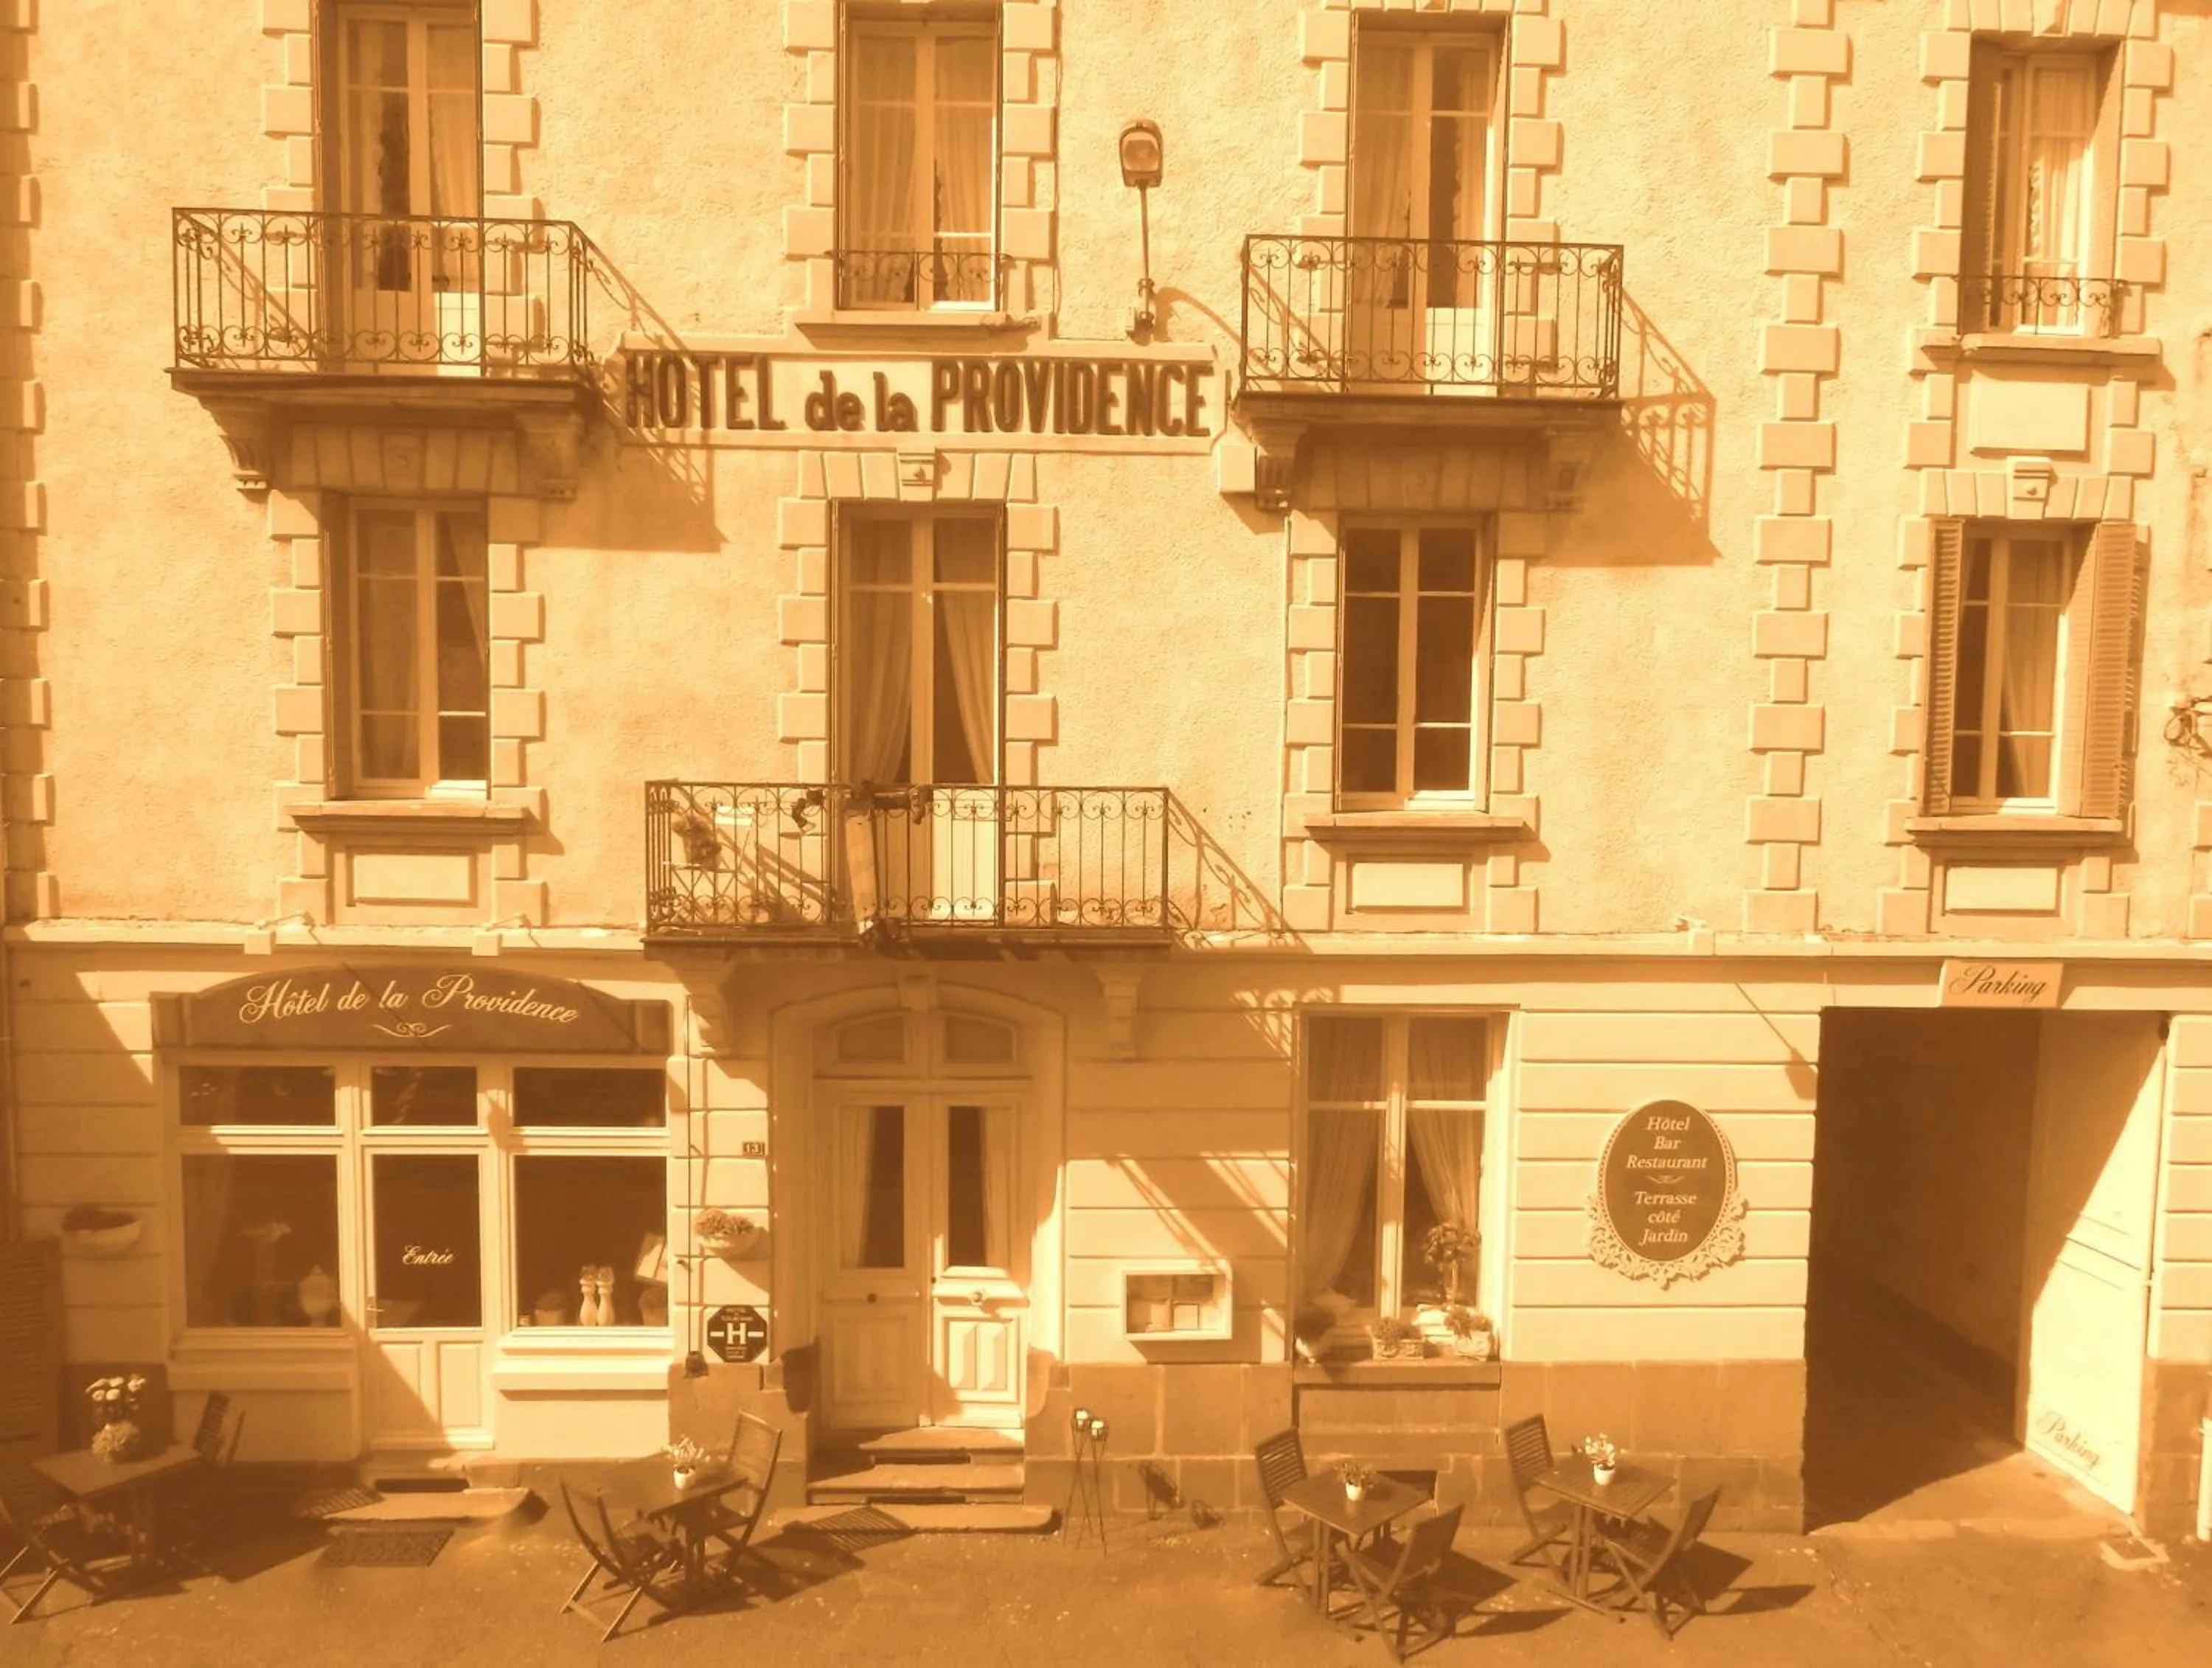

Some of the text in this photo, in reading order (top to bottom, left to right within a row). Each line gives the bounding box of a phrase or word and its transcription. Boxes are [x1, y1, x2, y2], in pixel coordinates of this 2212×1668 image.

[625, 353, 1214, 437] HOTEL de la PROVIDENCE
[1949, 965, 2047, 1006] Parking
[239, 973, 579, 1024] Hôtel de la Providence
[1646, 1116, 1691, 1131] Hôtel
[1653, 1136, 1682, 1150] Bar
[1626, 1155, 1709, 1170] Restaurant
[1635, 1191, 1698, 1205] Terrasse
[1648, 1209, 1681, 1224] côté
[1638, 1229, 1688, 1246] Jardin
[403, 1244, 455, 1265] Entrée
[726, 1322, 746, 1344] H
[2035, 1411, 2101, 1472] Parking
